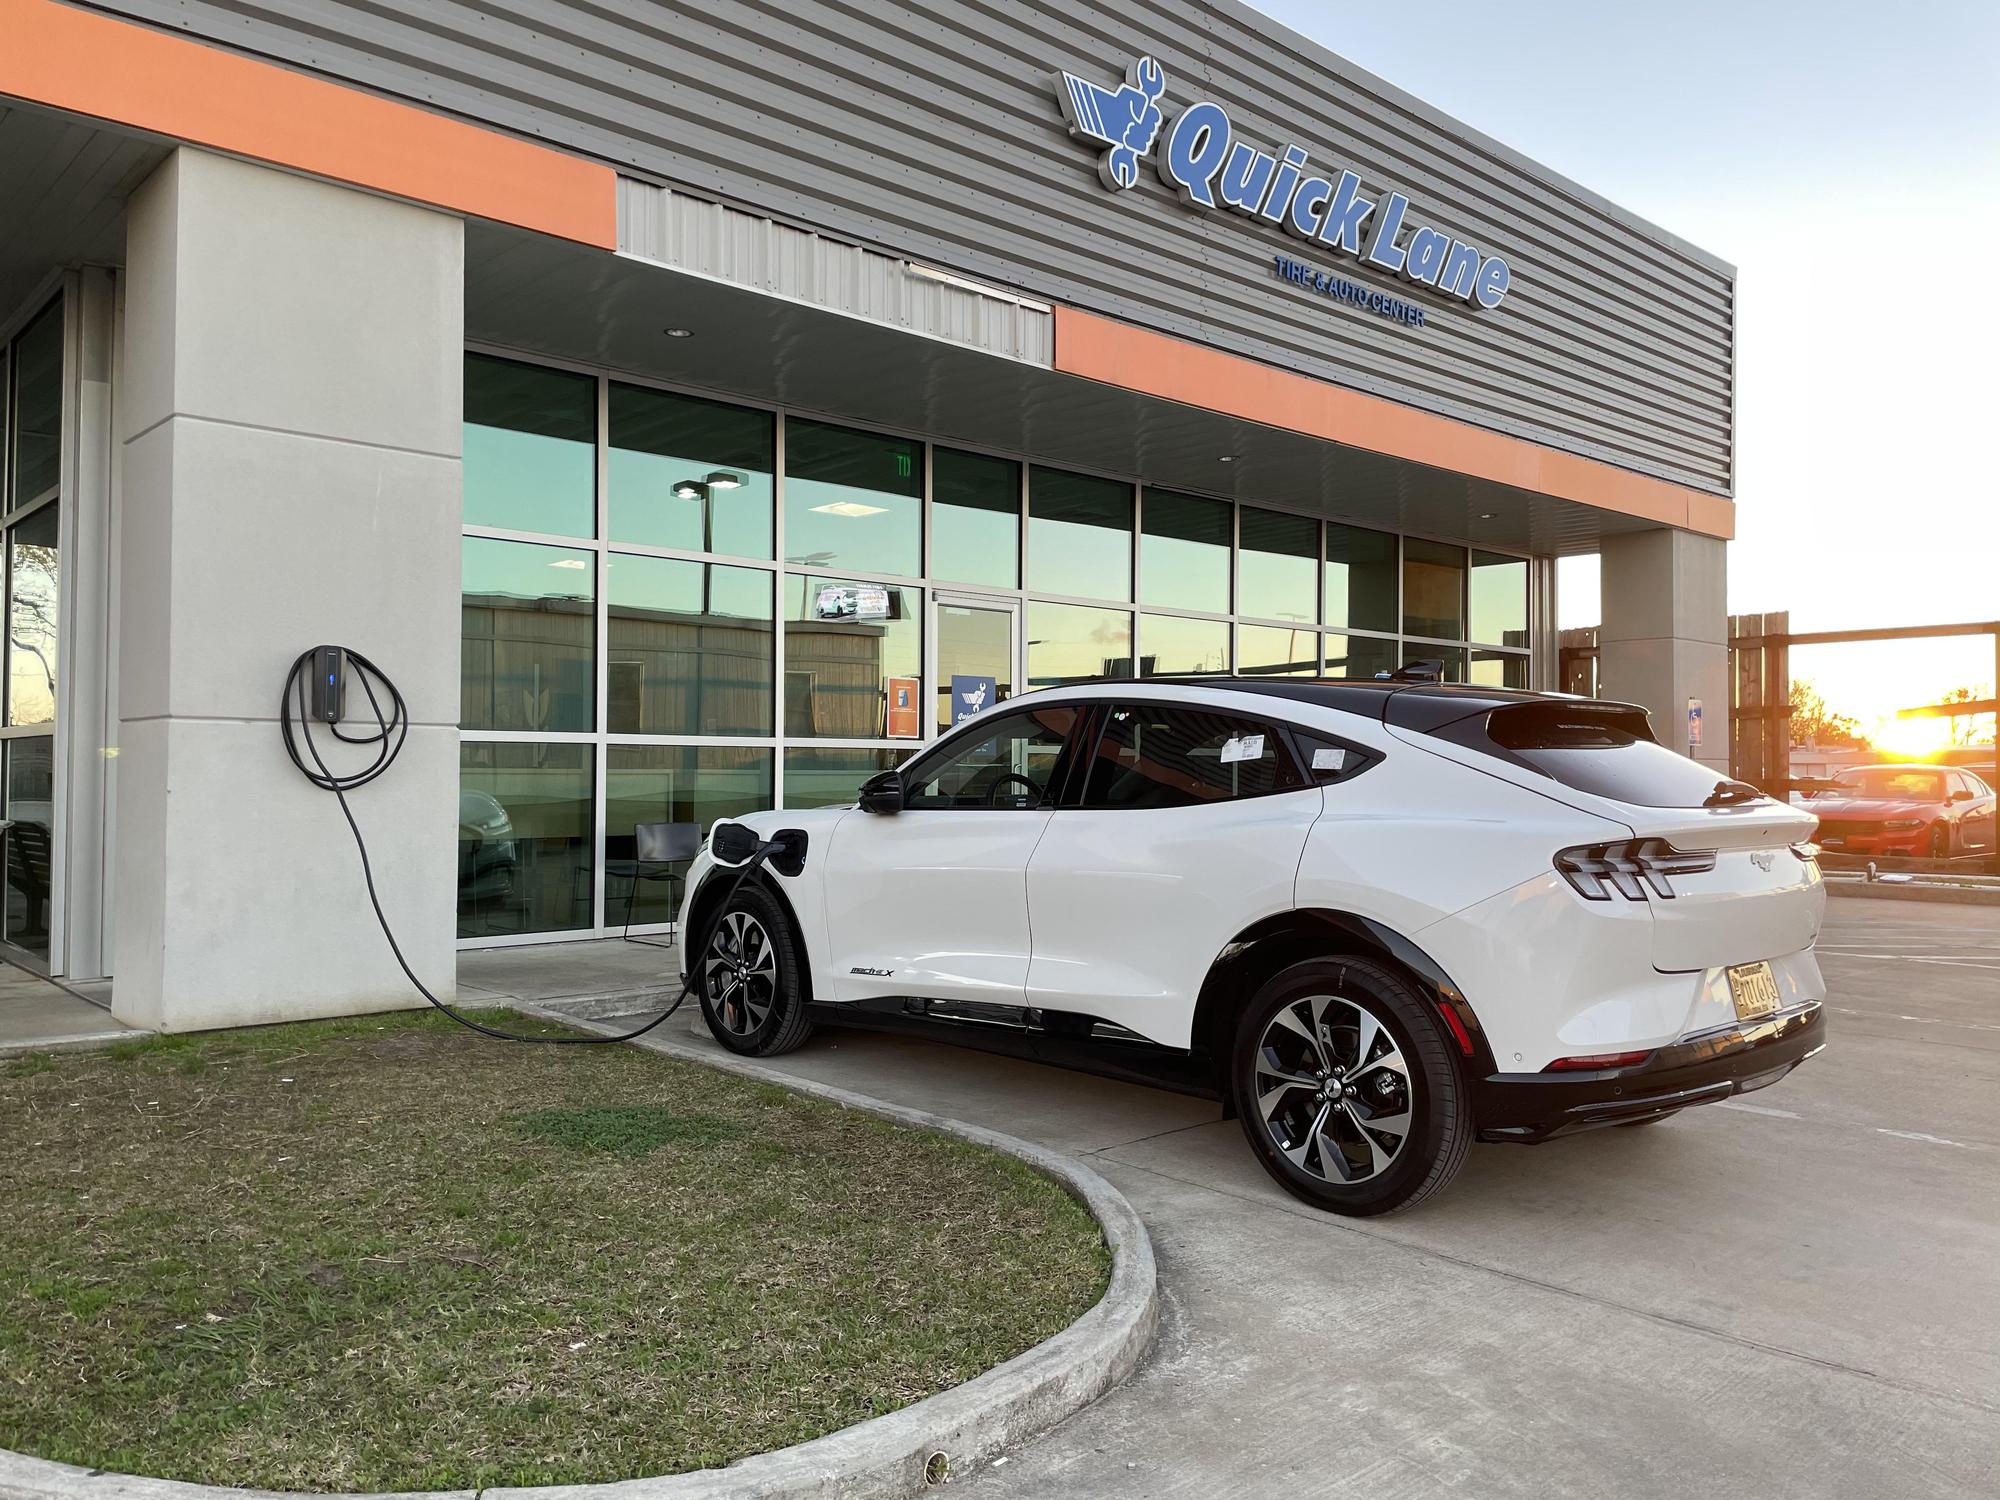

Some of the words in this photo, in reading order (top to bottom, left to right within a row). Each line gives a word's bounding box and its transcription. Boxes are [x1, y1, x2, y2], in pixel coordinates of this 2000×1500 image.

[1167, 101, 1377, 256] Quick
[1368, 191, 1511, 309] Lane
[1275, 255, 1313, 286] TIRE
[1315, 271, 1327, 291] &
[1328, 275, 1369, 305] AUTO
[1371, 291, 1426, 327] CENTER
